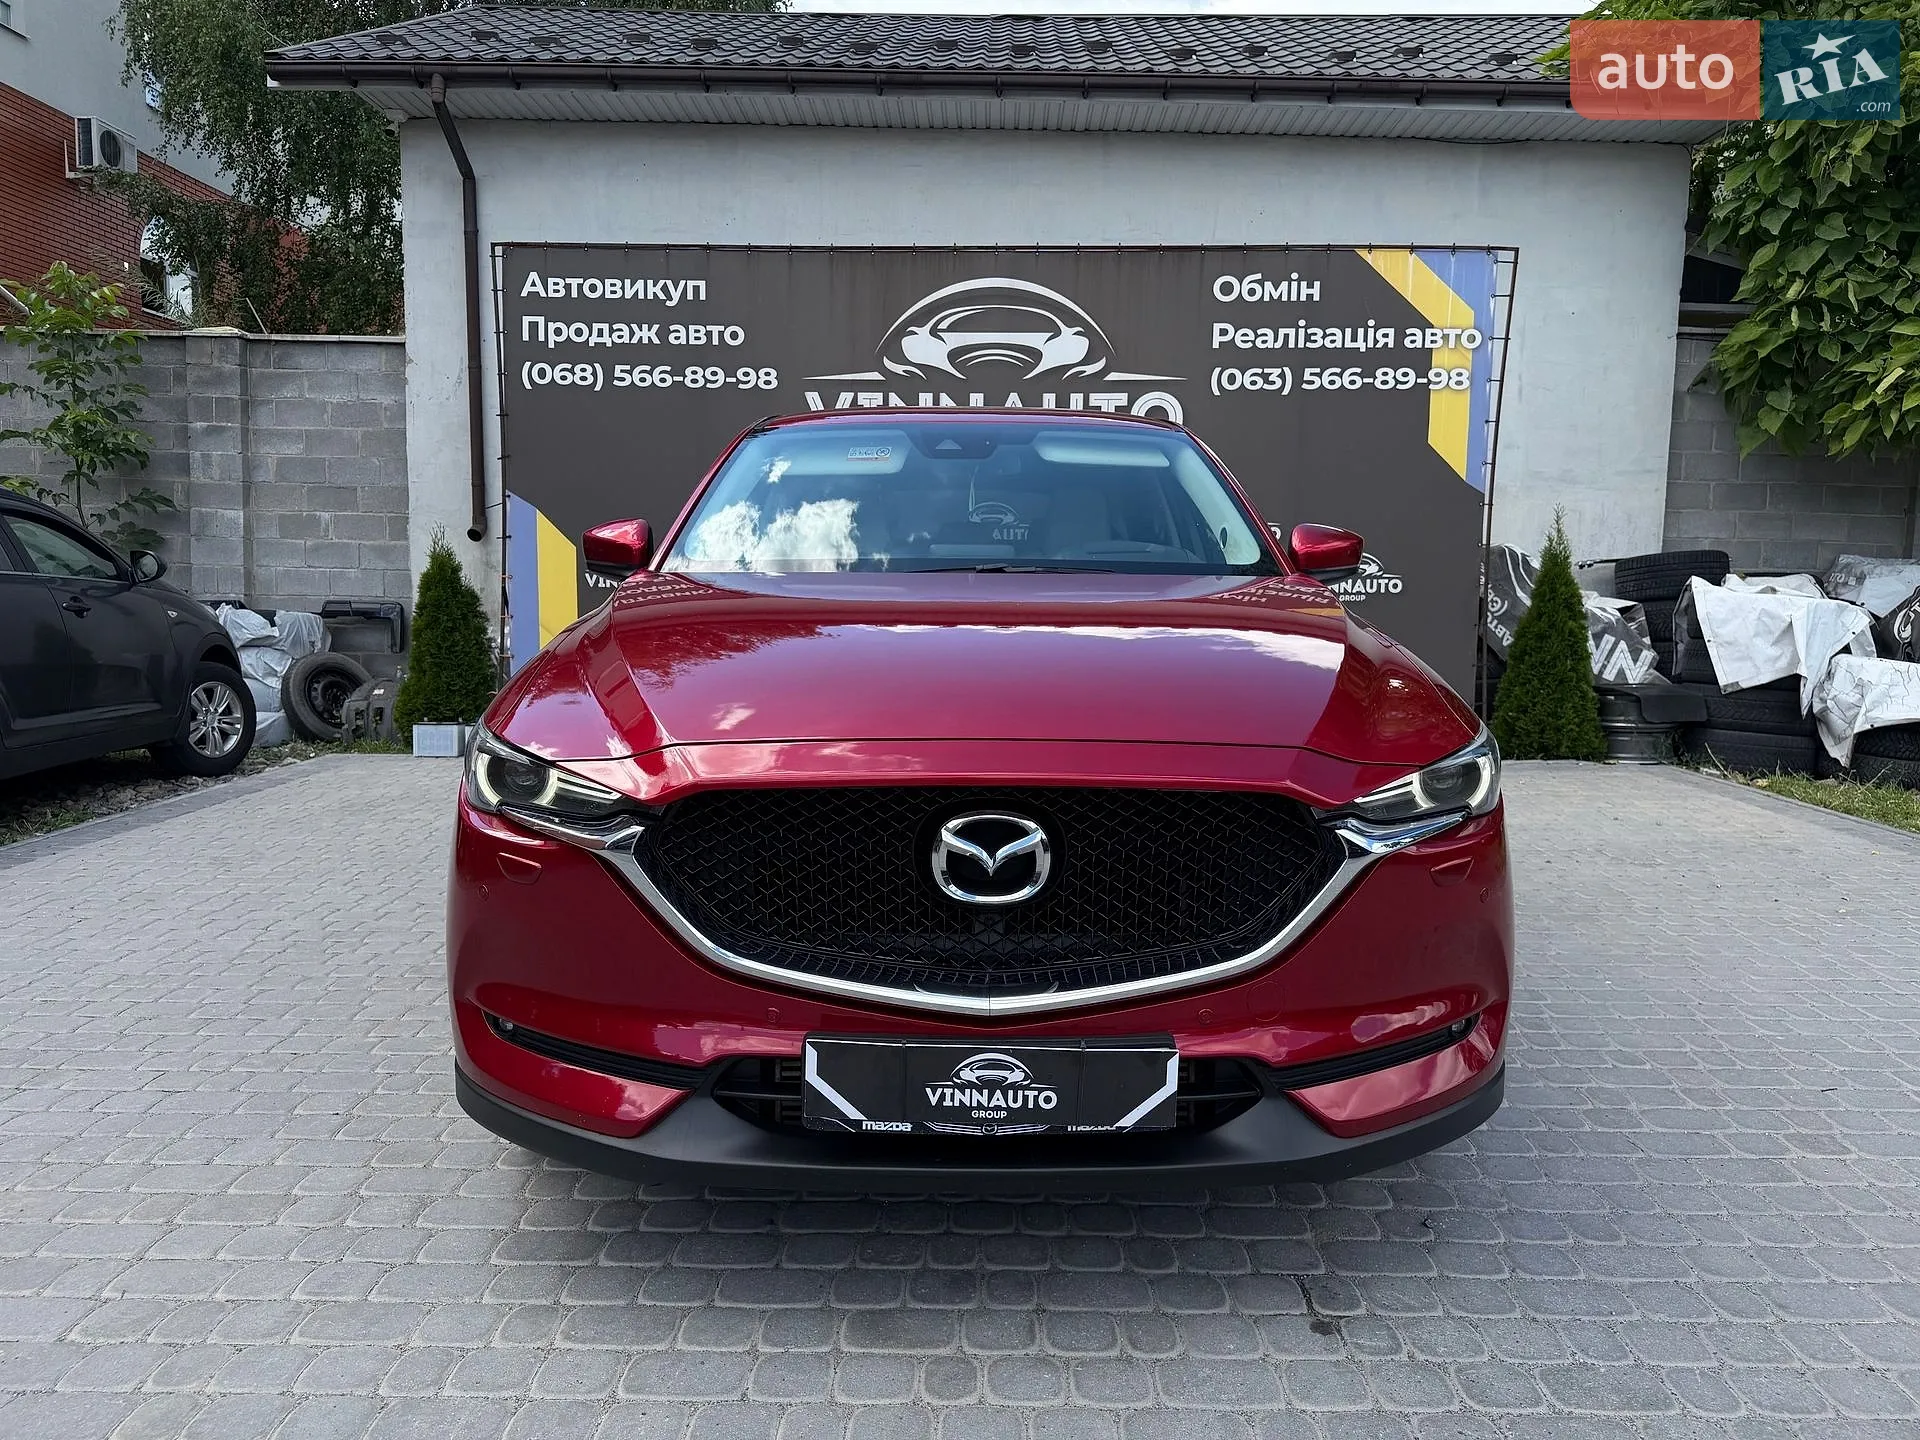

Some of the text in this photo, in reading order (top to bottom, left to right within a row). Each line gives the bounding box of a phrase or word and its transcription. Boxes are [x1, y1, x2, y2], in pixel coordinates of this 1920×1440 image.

[520, 271, 706, 306] Автовикуп
[1212, 273, 1321, 303] Обмін
[522, 316, 745, 348] Продаж авто
[1212, 319, 1482, 352] Реалізація авто
[521, 362, 779, 391] (068) 566-89-98
[1210, 367, 1471, 396] (063) 566-89-98
[925, 1088, 1058, 1110] VINNAUTO
[862, 1121, 912, 1132] mazda
[971, 1110, 1008, 1119] GROUP
